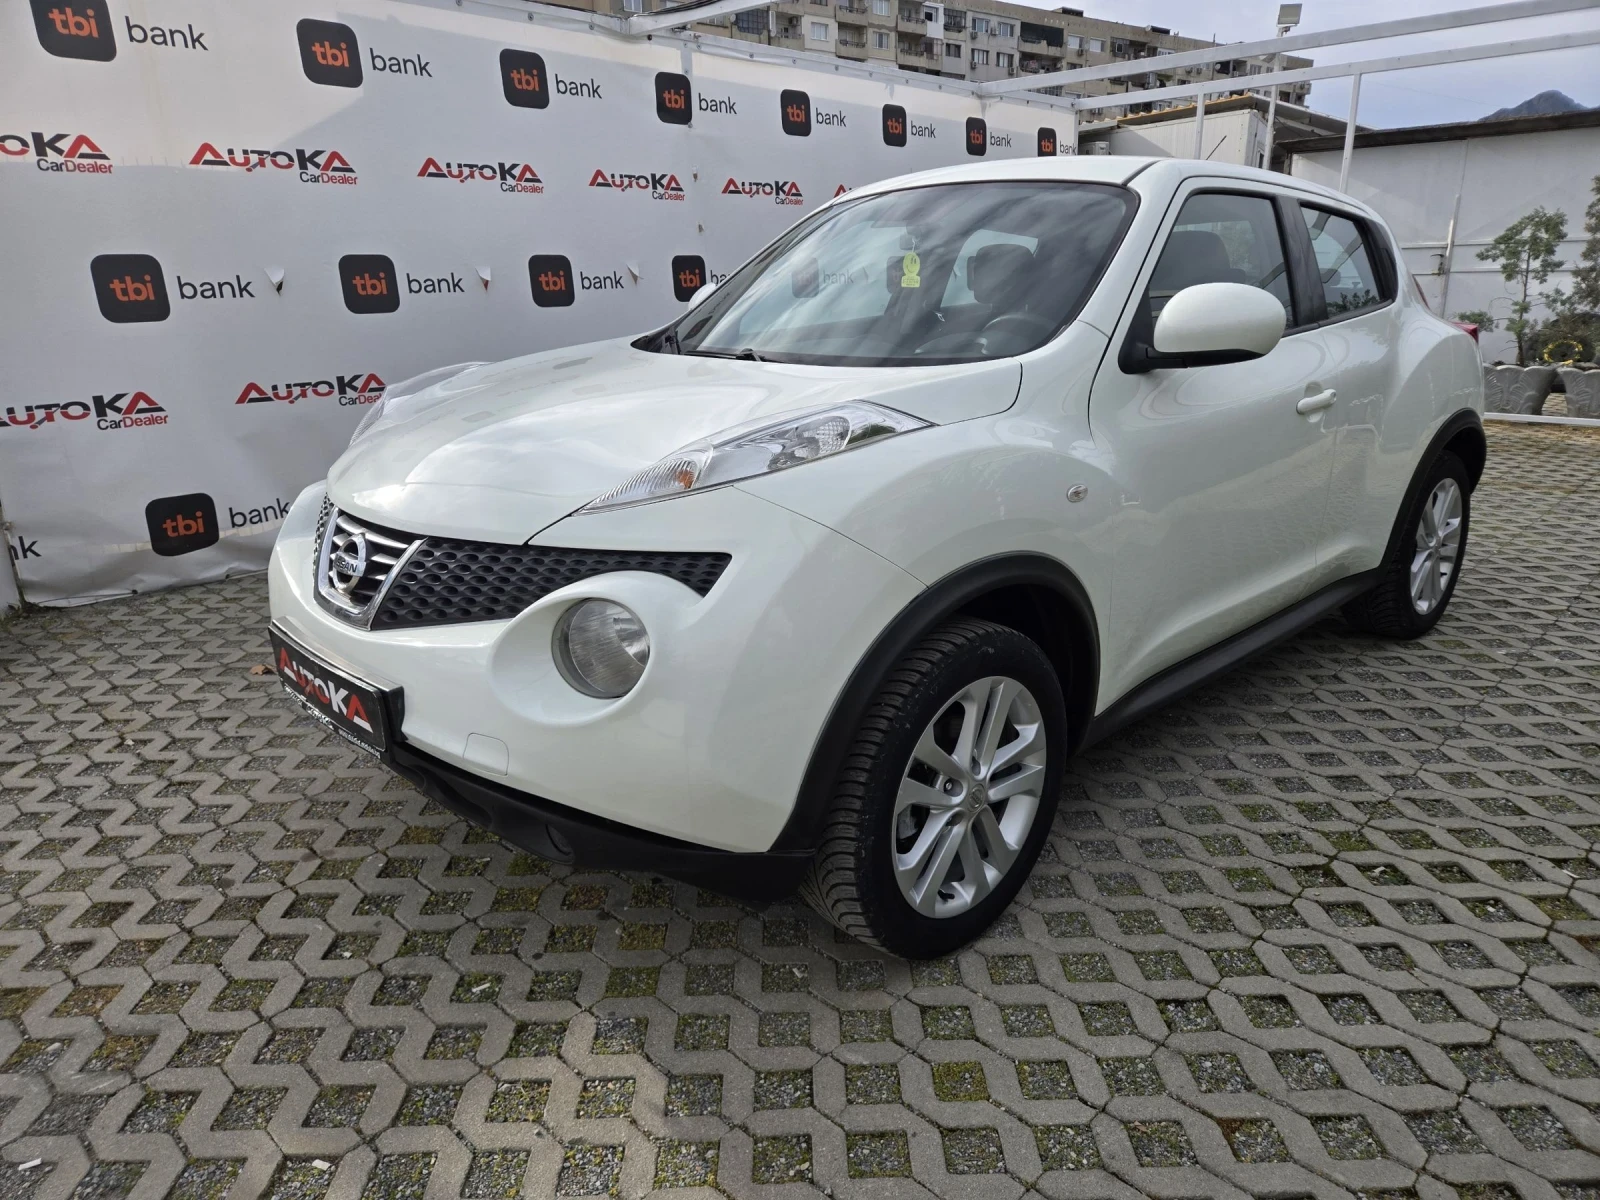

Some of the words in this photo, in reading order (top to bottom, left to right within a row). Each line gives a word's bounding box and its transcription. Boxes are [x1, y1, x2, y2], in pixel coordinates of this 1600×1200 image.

[48, 8, 99, 38] tbi
[125, 16, 208, 51] bank
[312, 41, 350, 68] tbi
[370, 48, 432, 77] bank
[511, 68, 540, 91] tbi
[555, 74, 602, 99] bank
[663, 88, 685, 110] tbi
[698, 93, 737, 115] bank
[787, 105, 806, 123] tbi
[815, 107, 846, 127] bank
[887, 117, 903, 135] tbi
[910, 120, 936, 139] bank
[970, 129, 983, 144] tbi
[989, 131, 1011, 148] bank
[1041, 139, 1053, 153] tbi
[1060, 140, 1076, 155] bank
[37, 158, 113, 174] CarDealer
[300, 171, 358, 185] CarDealer
[500, 180, 544, 194] CarDealer
[652, 190, 685, 201] CarDealer
[775, 196, 803, 206] CarDealer
[111, 274, 155, 301] tbi
[177, 275, 255, 299] bank
[353, 273, 387, 295] tbi
[406, 272, 465, 294] bank
[539, 270, 565, 291] tbi
[580, 271, 624, 290] bank
[679, 270, 700, 288] tbi
[710, 270, 730, 285] ba
[0, 391, 166, 429] UTOKA
[97, 414, 168, 431] CarDealer
[163, 512, 204, 537] tbi
[229, 498, 290, 529] bank
